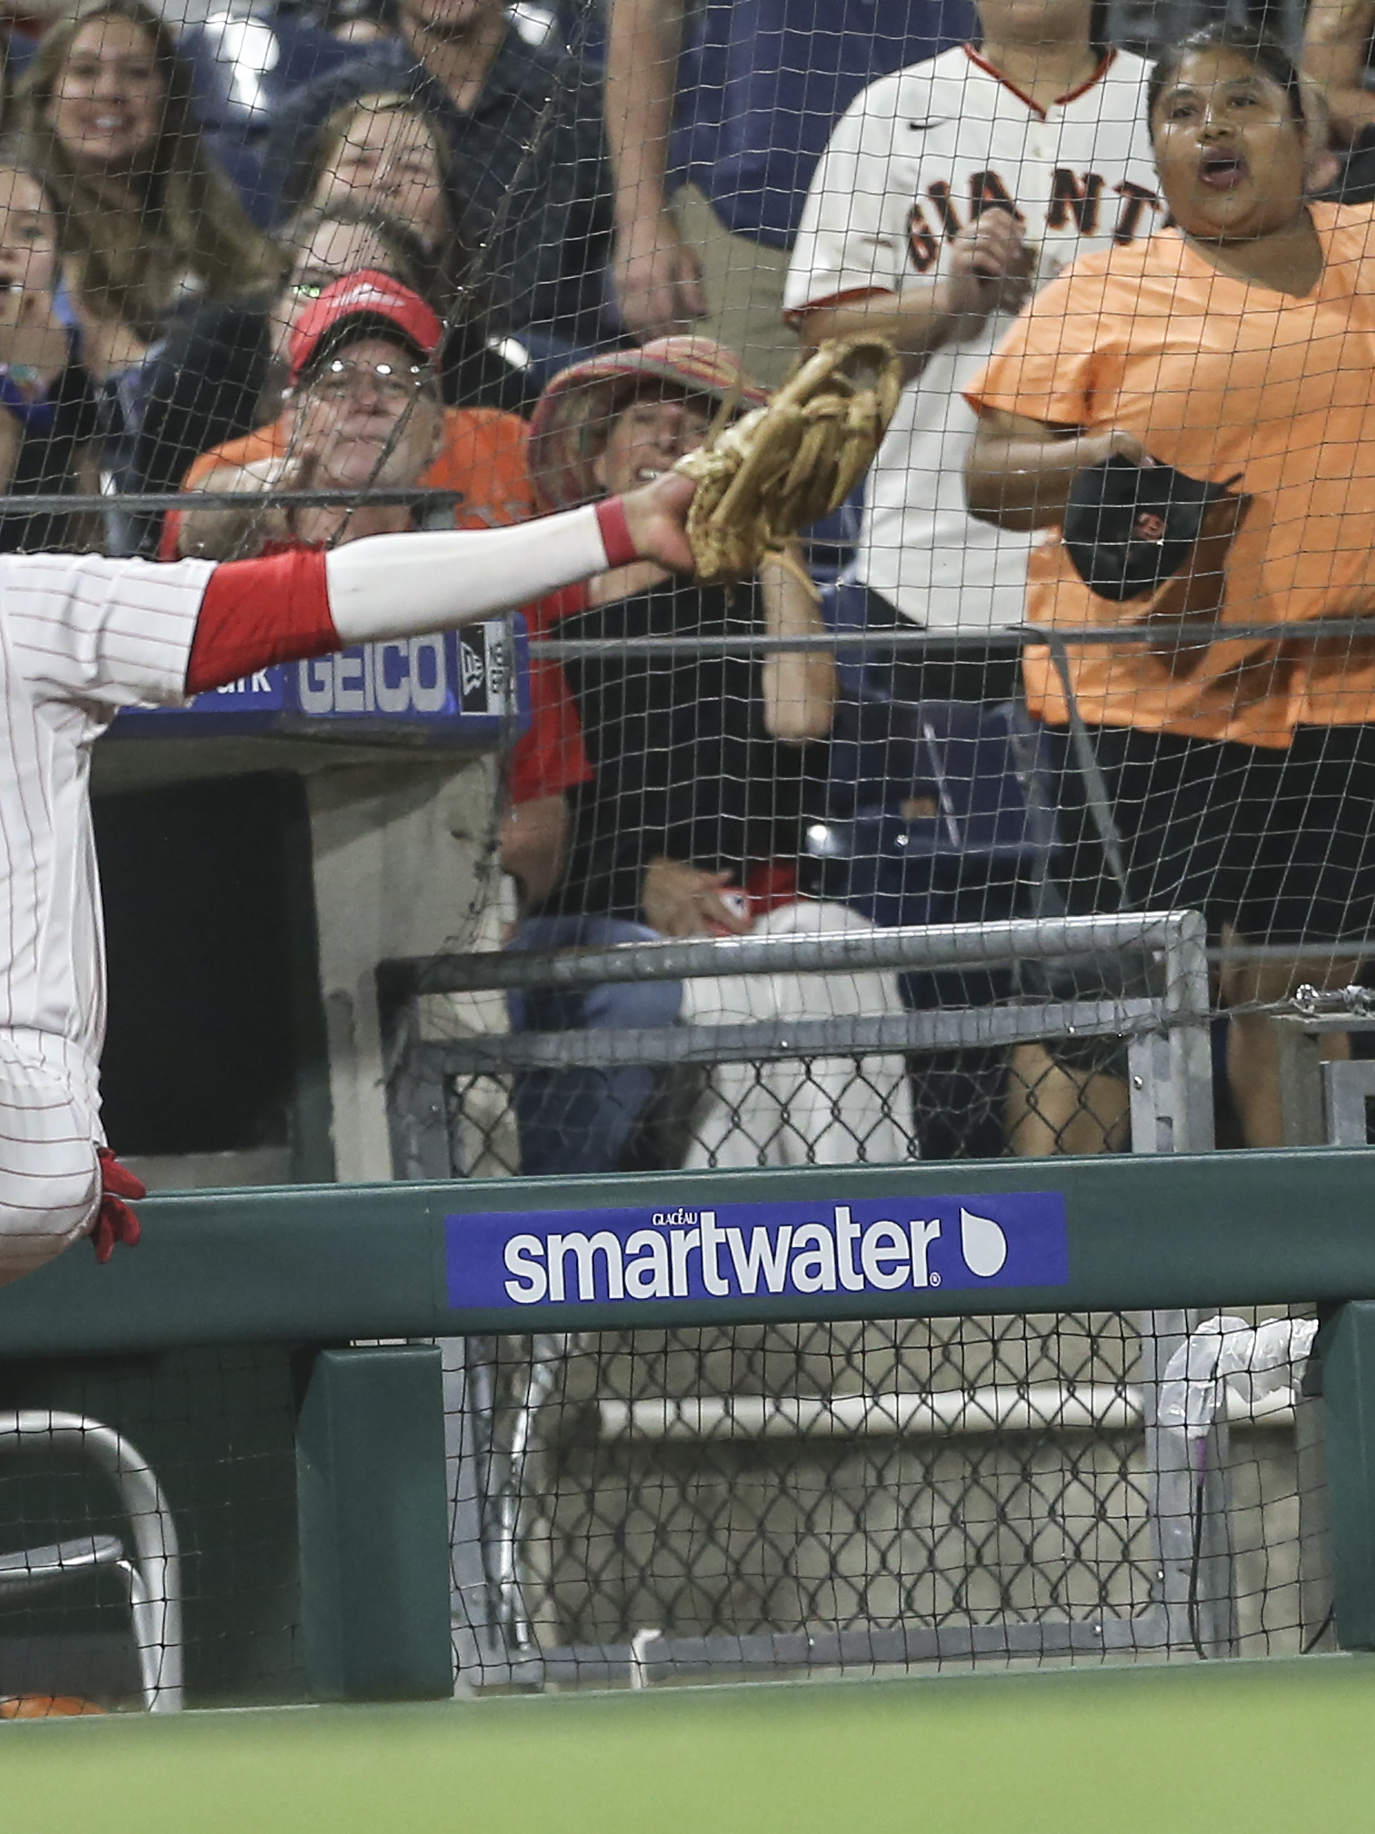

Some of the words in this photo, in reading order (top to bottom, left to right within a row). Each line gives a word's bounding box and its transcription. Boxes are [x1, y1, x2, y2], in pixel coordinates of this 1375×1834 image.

[906, 168, 1177, 273] GIANT
[298, 633, 447, 714] GEICO
[504, 1206, 942, 1304] smartwater
